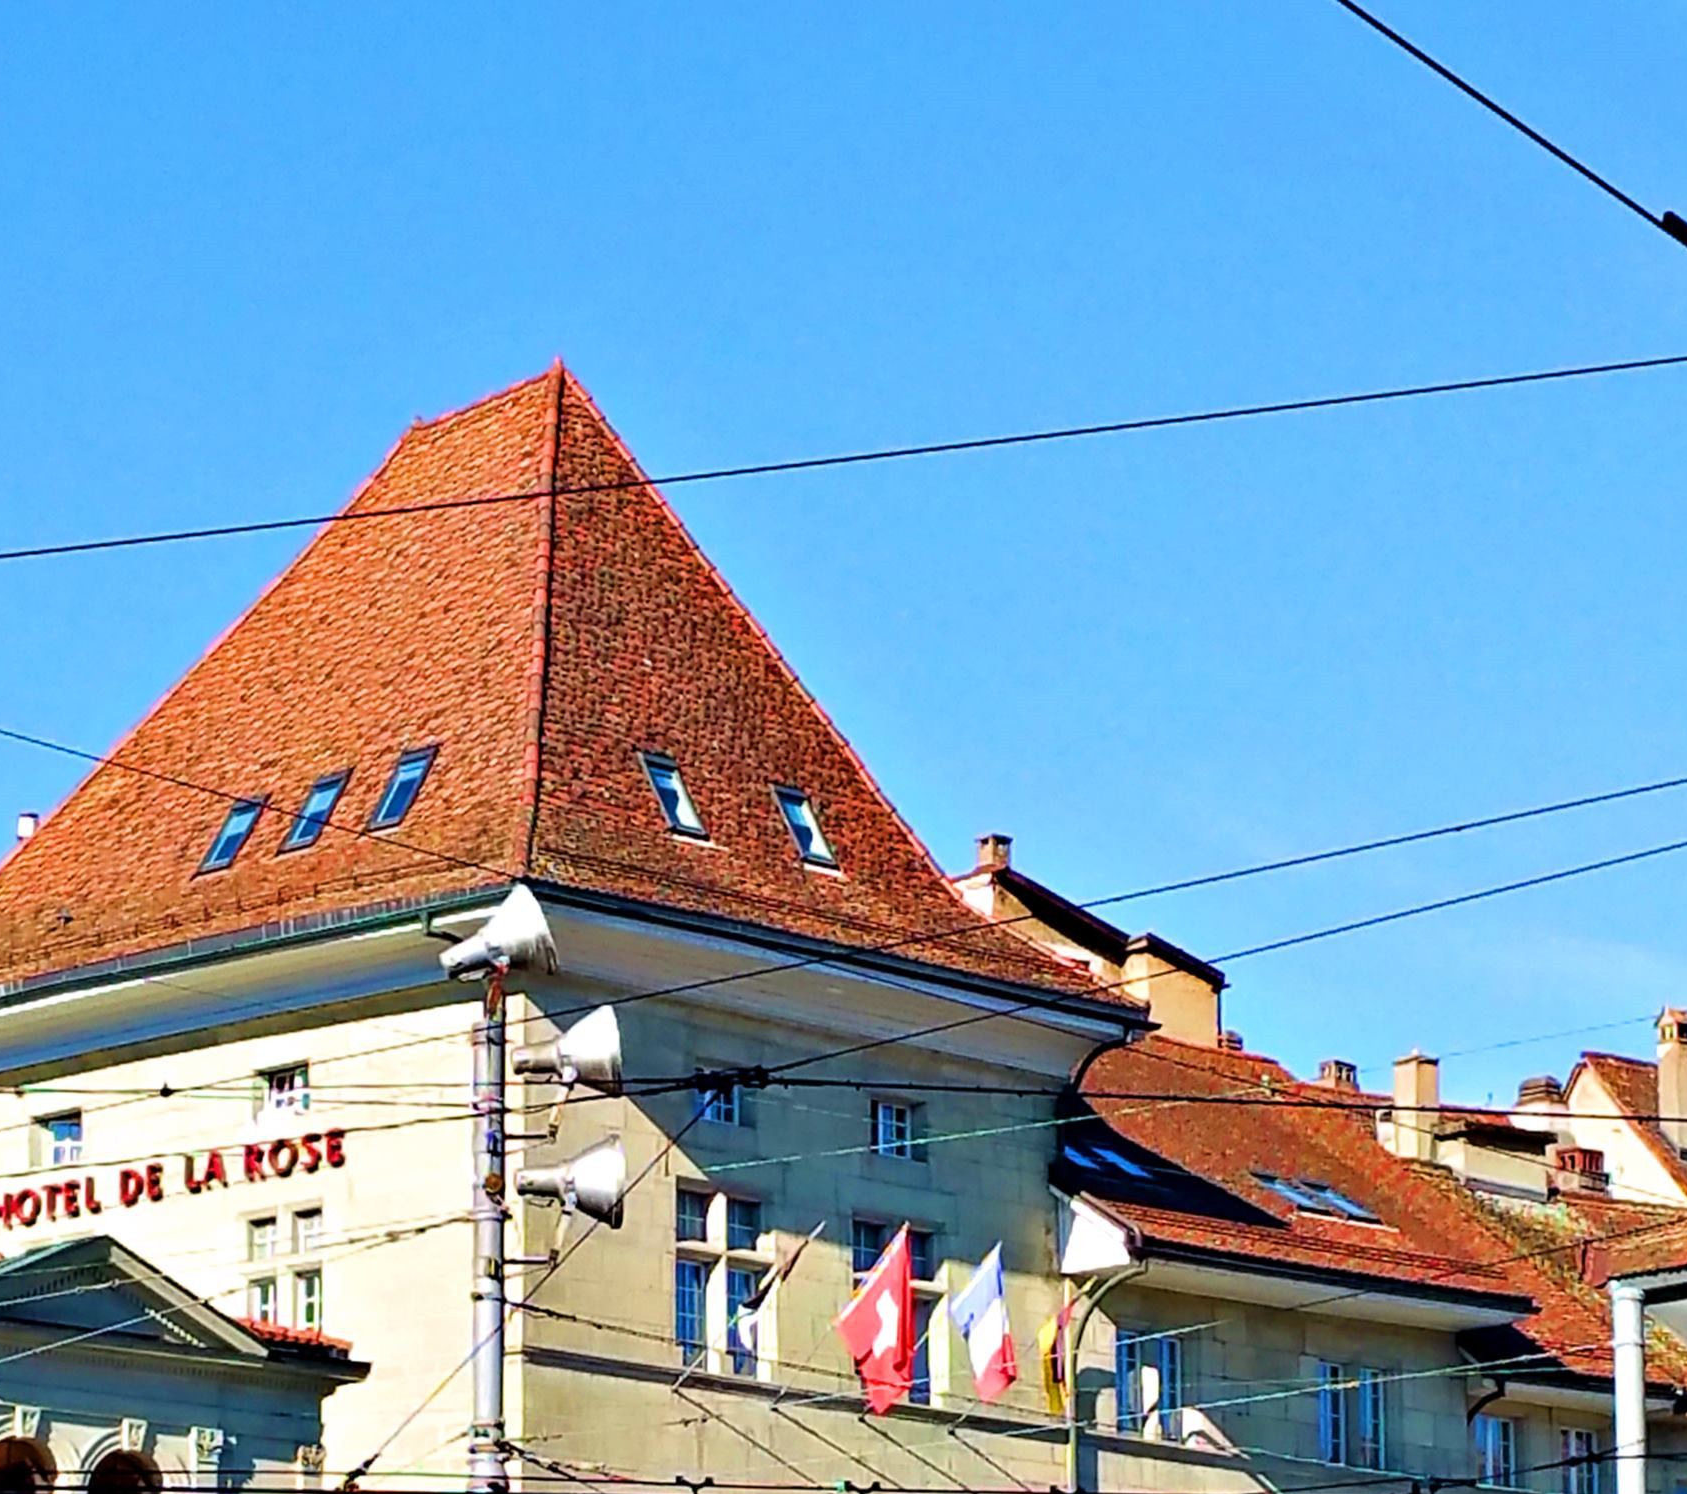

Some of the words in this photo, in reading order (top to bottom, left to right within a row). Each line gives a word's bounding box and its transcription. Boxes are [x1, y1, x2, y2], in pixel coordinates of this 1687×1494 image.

[120, 1162, 164, 1207] DE
[185, 1147, 228, 1194] LA
[244, 1128, 345, 1183] ROSE
